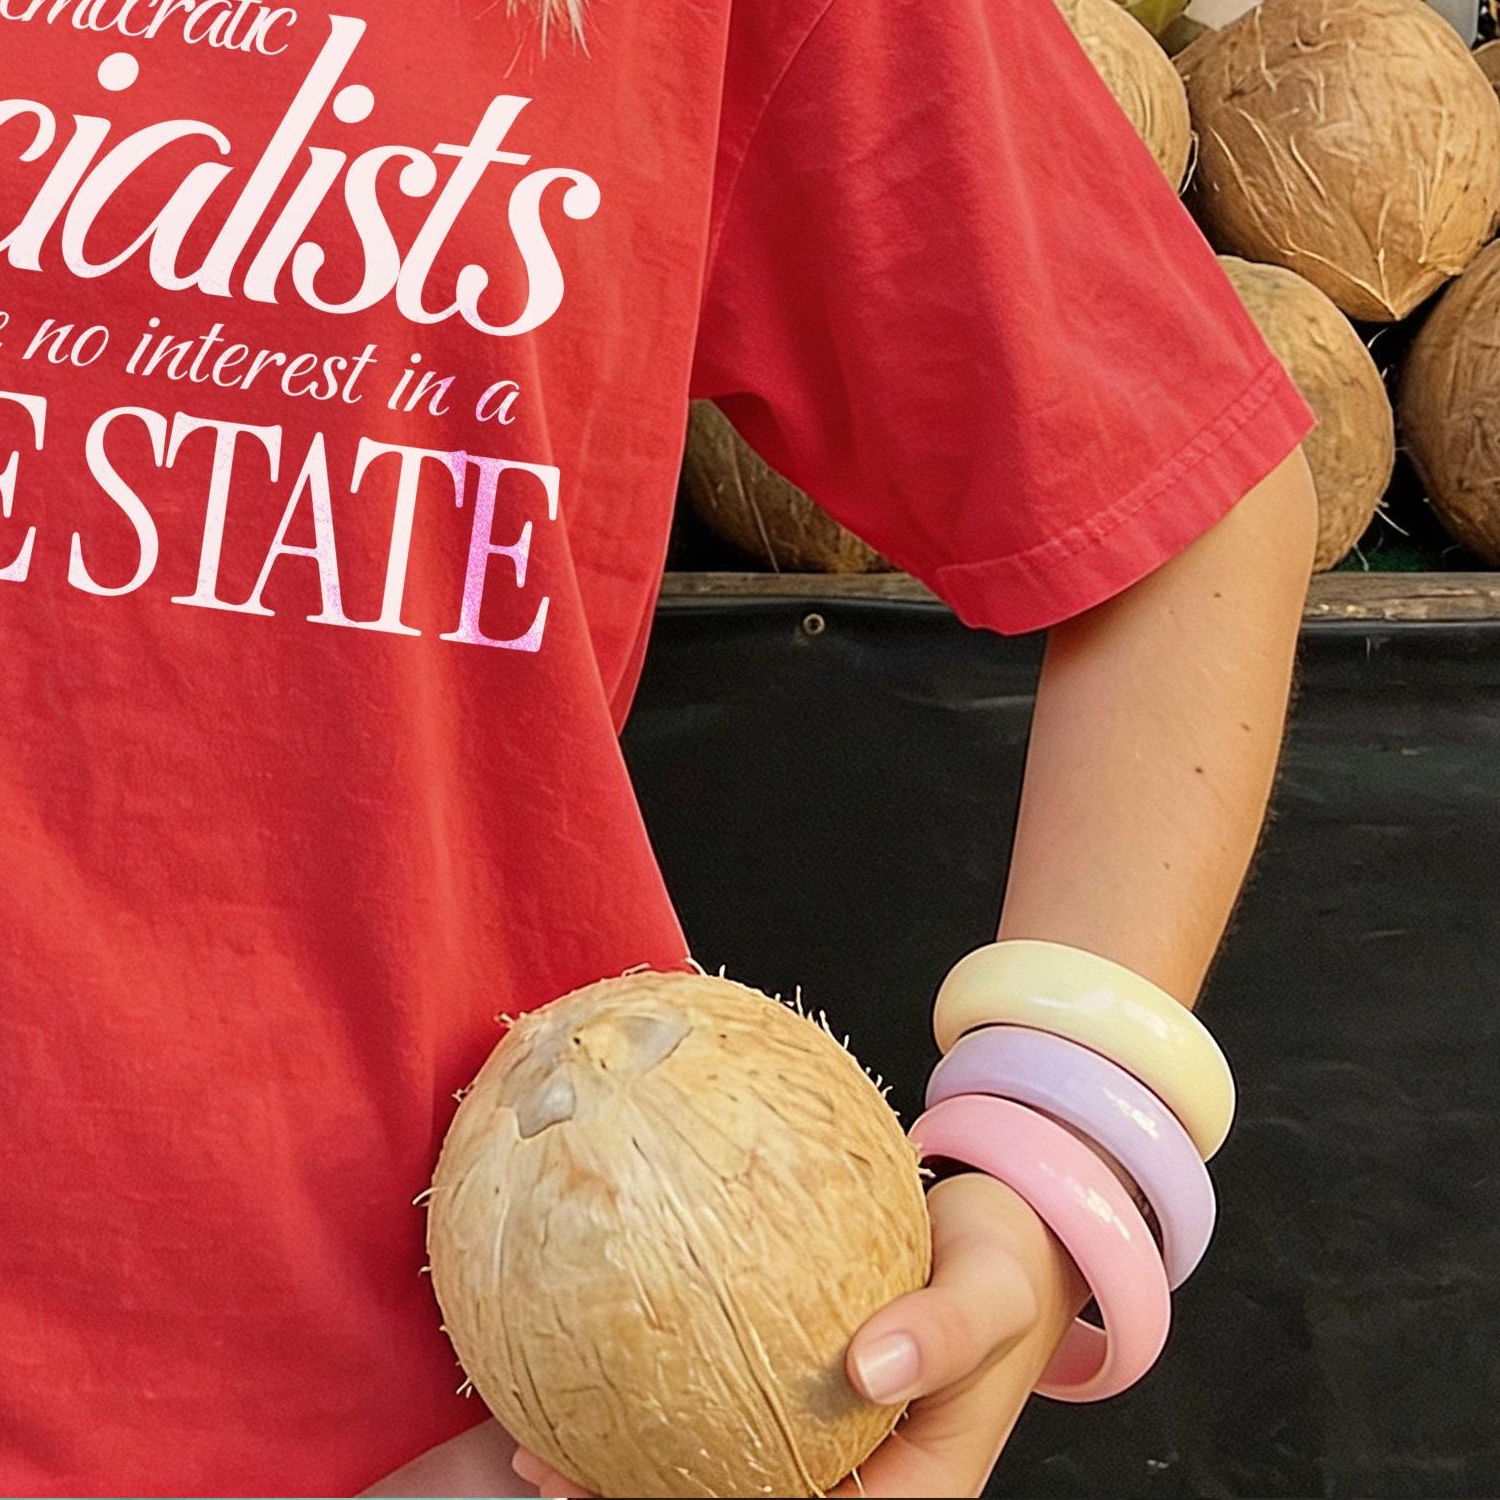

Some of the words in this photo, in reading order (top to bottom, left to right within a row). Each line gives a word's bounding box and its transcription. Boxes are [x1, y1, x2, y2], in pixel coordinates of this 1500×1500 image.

[22, 318, 110, 367] no
[125, 316, 377, 405] interest
[387, 352, 457, 418] in
[474, 379, 521, 426] a
[67, 405, 562, 654] STATE
